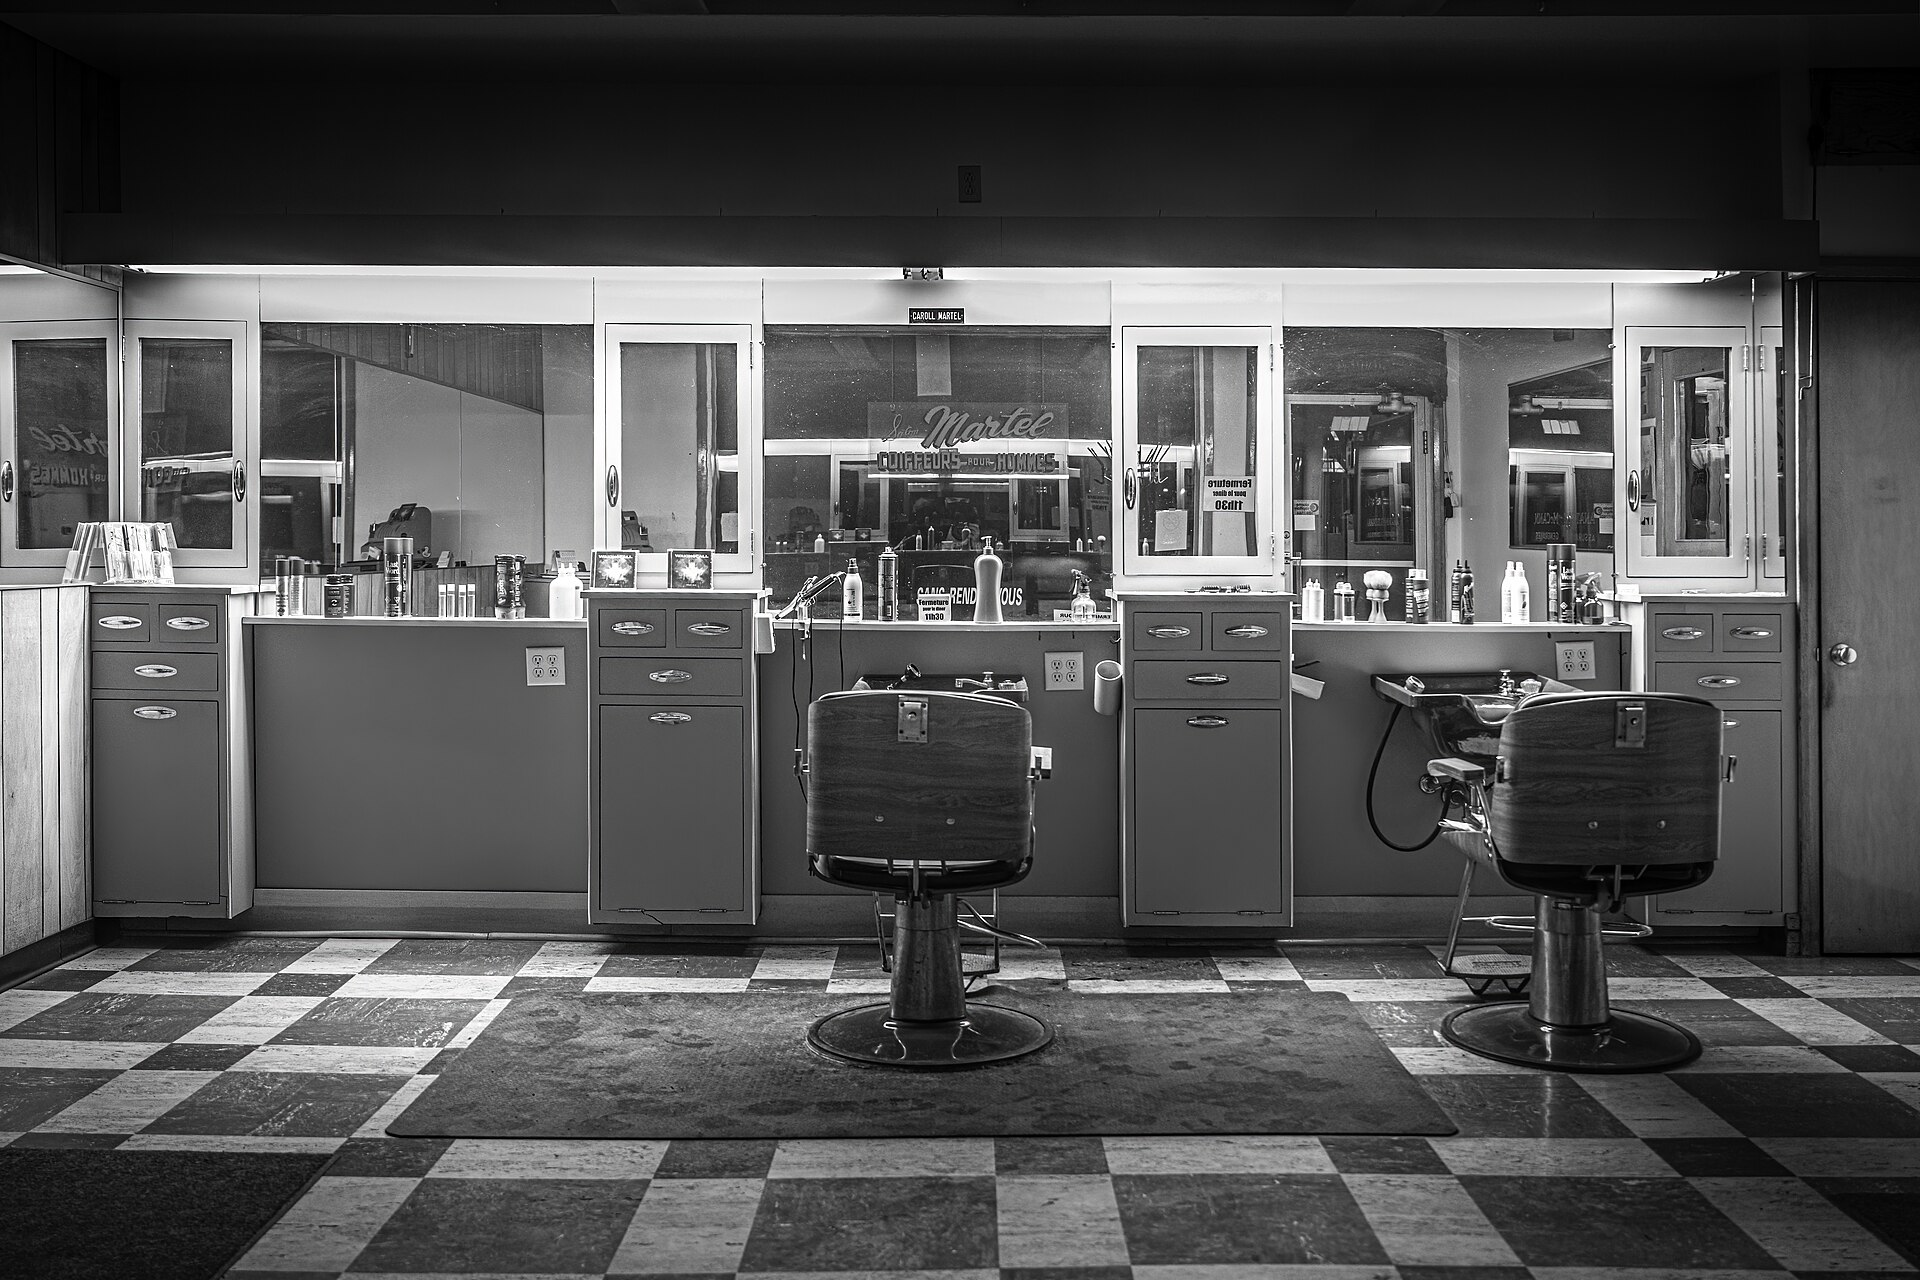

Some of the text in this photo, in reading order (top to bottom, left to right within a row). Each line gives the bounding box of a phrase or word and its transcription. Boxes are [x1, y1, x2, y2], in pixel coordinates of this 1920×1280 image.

[912, 311, 961, 320] CAROLL MARTEL
[920, 405, 1054, 449] Martel
[877, 450, 1057, 473] COIFFEURS POUR HOMMES
[919, 599, 949, 607] Fermeture
[925, 613, 944, 621] 11h30
